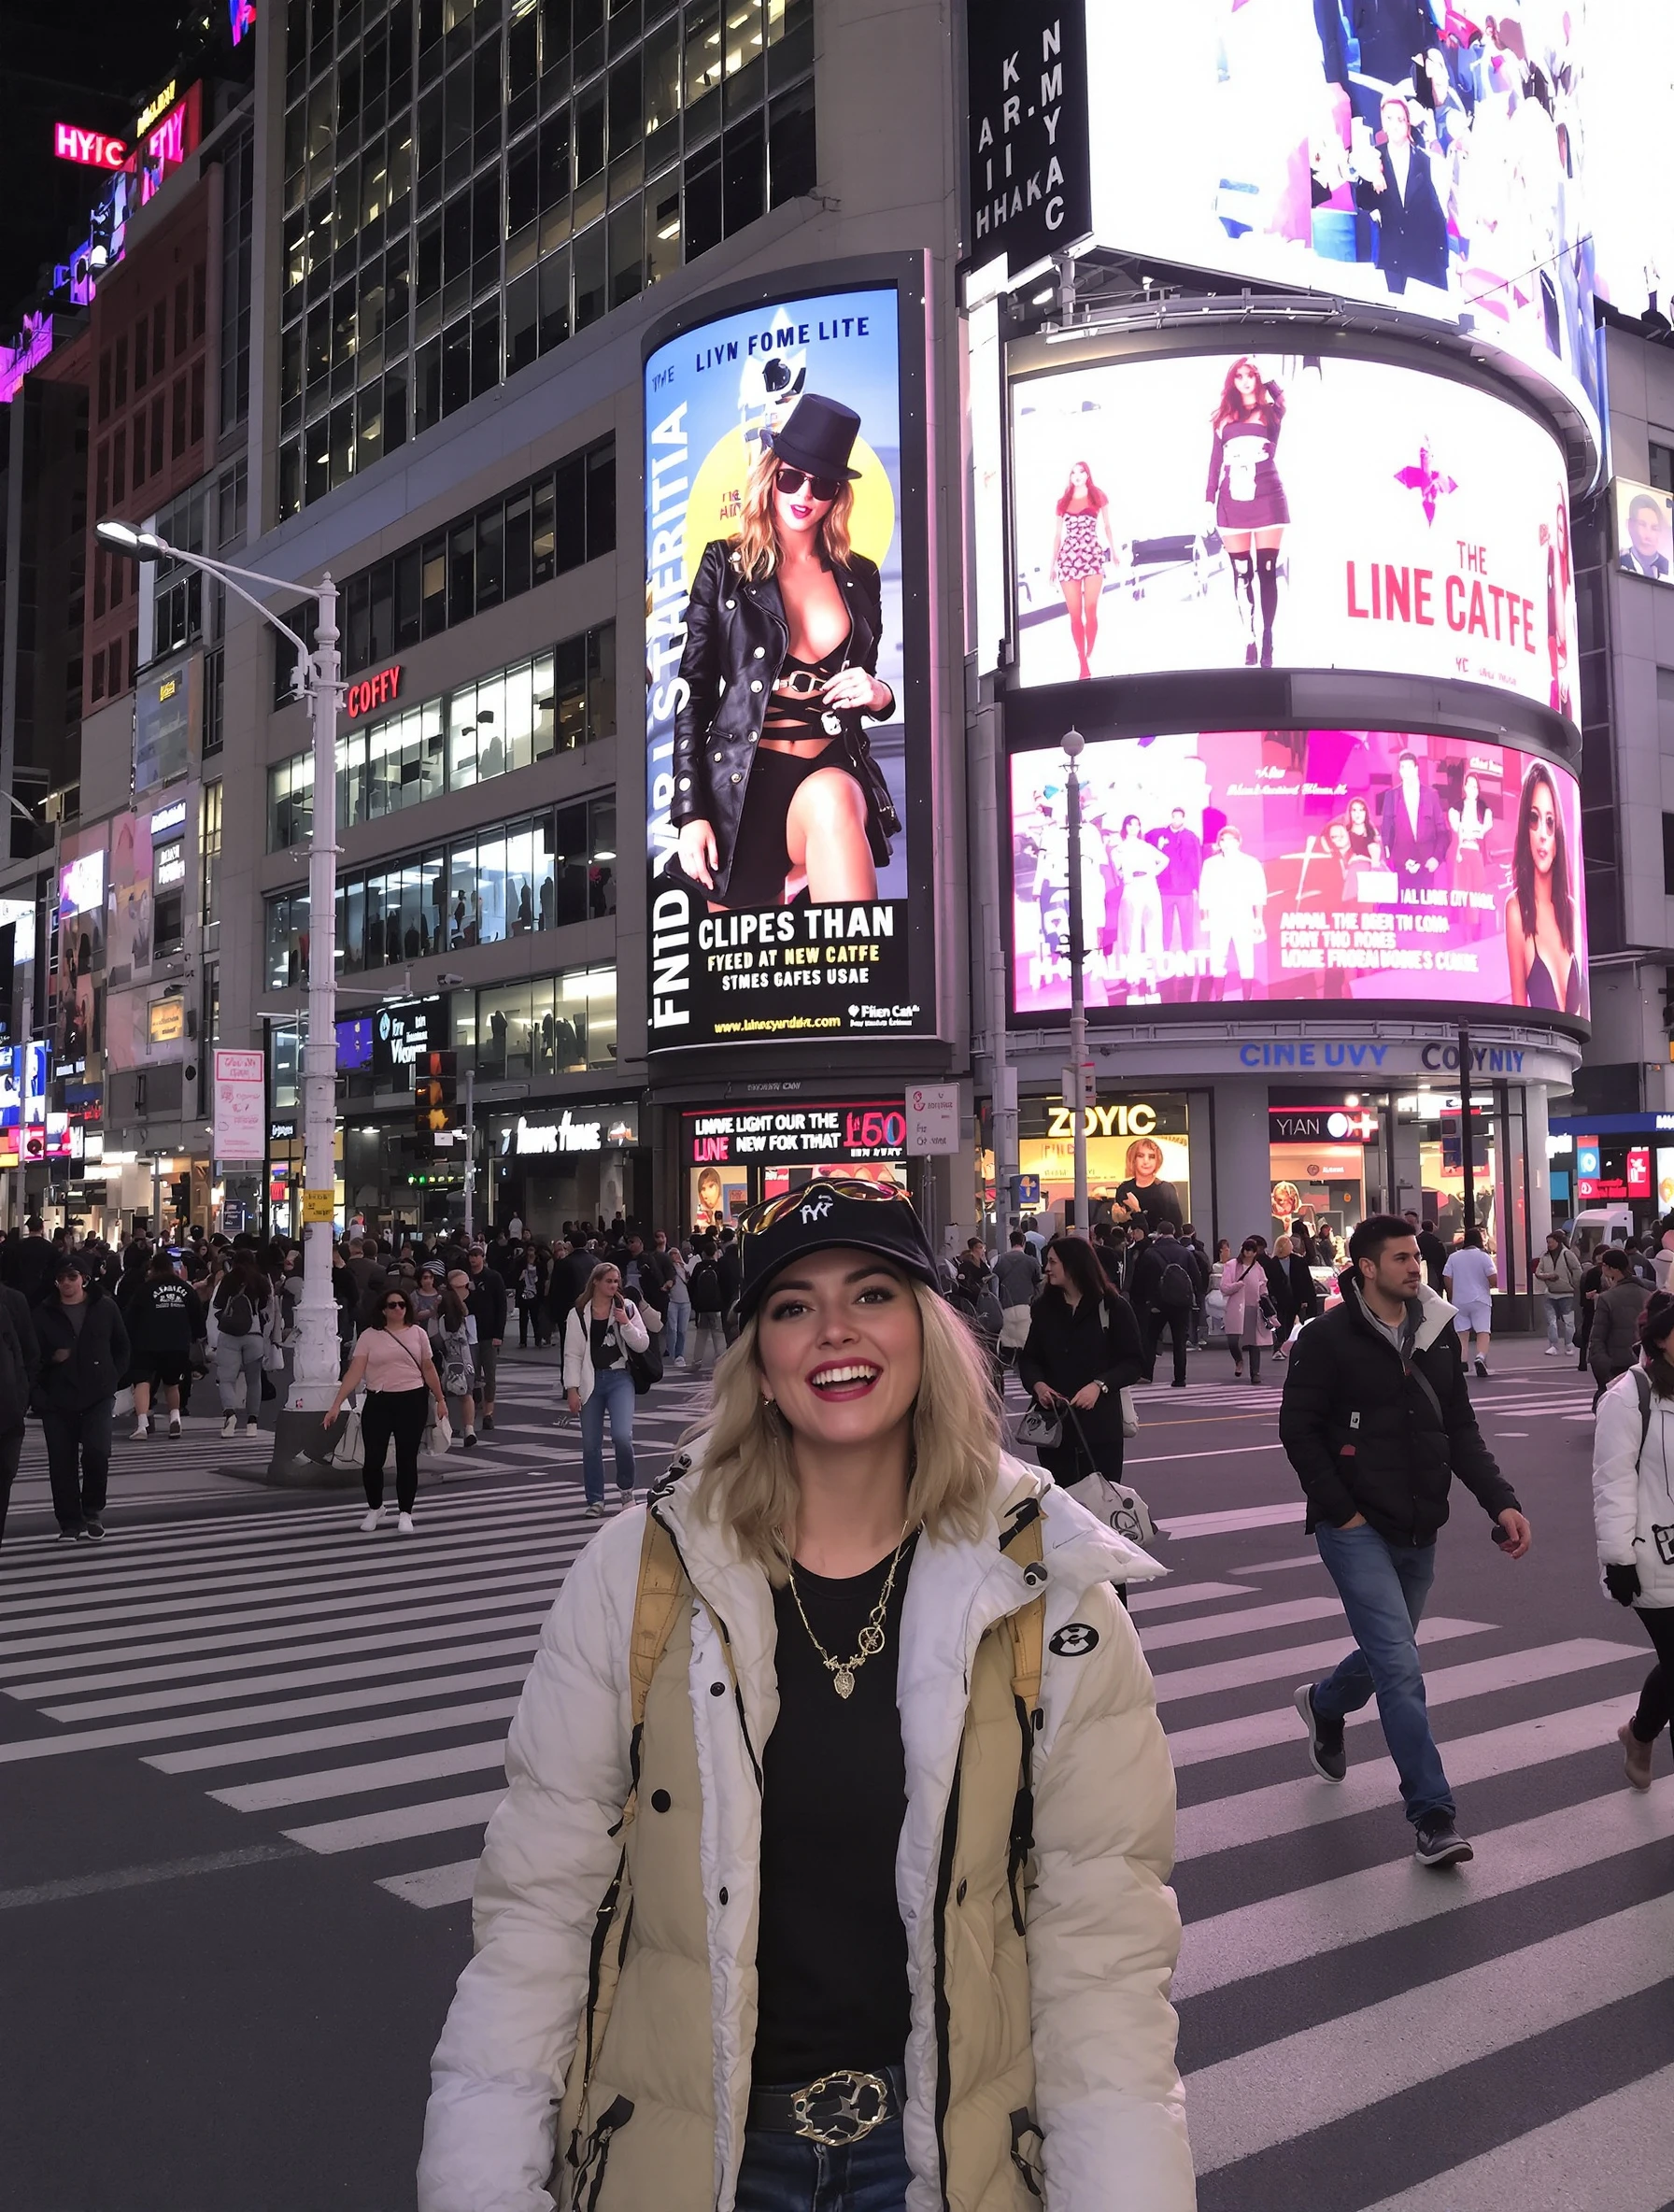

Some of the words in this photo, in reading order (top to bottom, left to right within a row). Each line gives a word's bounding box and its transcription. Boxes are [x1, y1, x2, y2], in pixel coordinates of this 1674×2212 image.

[696, 341, 739, 373] LIVN
[748, 323, 811, 356] FOME
[818, 316, 870, 341] LITE
[1456, 540, 1487, 575] THE
[1346, 560, 1434, 626] LINE
[1446, 574, 1536, 655] CATFE
[348, 664, 401, 718] COFFY
[698, 911, 795, 950] CLIPES
[803, 905, 894, 941] THAN
[758, 949, 777, 967] AT
[785, 947, 820, 965] NEW
[826, 944, 880, 963] CATFE
[827, 967, 869, 984] USAE
[1240, 1042, 1315, 1068] CINE
[1325, 1042, 1389, 1068] UVY
[775, 1113, 806, 1131] OUR
[809, 1112, 840, 1130] THE
[736, 1135, 766, 1153] NEW
